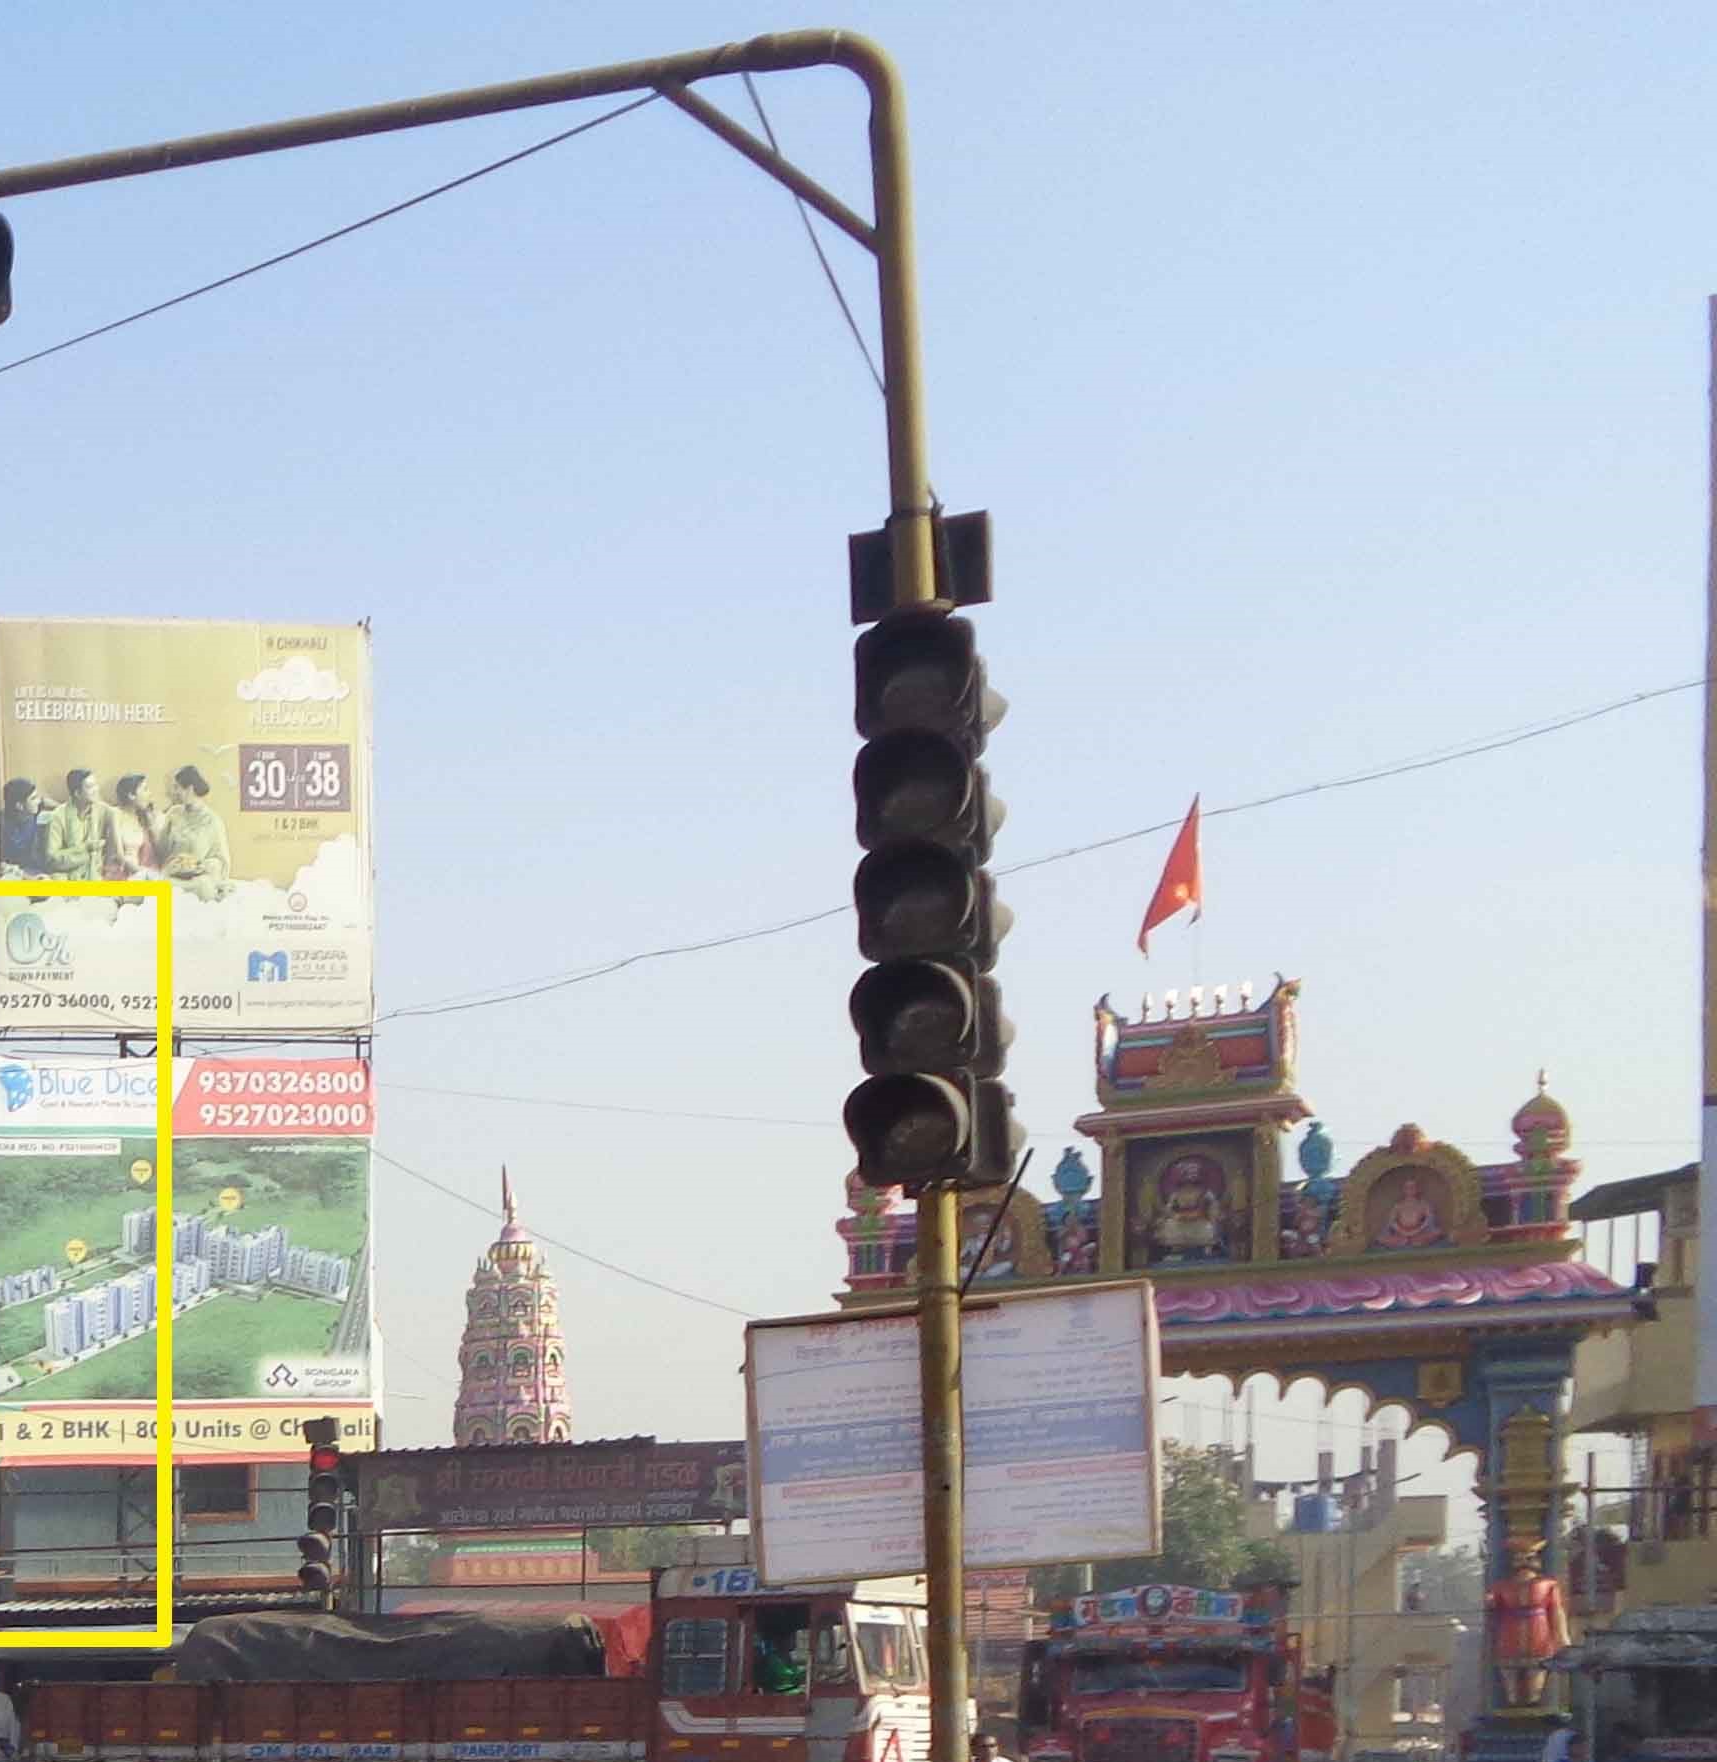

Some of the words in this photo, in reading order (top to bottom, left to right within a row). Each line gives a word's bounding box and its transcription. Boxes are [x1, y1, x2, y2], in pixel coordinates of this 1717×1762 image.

[15, 701, 120, 721] CELEBRATION
[124, 703, 166, 721] HERE
[248, 761, 286, 798] 30
[305, 760, 341, 798] 38
[0, 994, 52, 1010] 95270
[58, 993, 115, 1012] 36000,
[179, 995, 233, 1010] 25000
[39, 1068, 94, 1094] Blue
[199, 1071, 366, 1095] 9370326800
[200, 1103, 366, 1127] 9527023000
[16, 1422, 32, 1440] &
[41, 1422, 55, 1439] 2
[63, 1420, 110, 1439] BHK
[185, 1419, 242, 1438] Units
[249, 1419, 272, 1439] @
